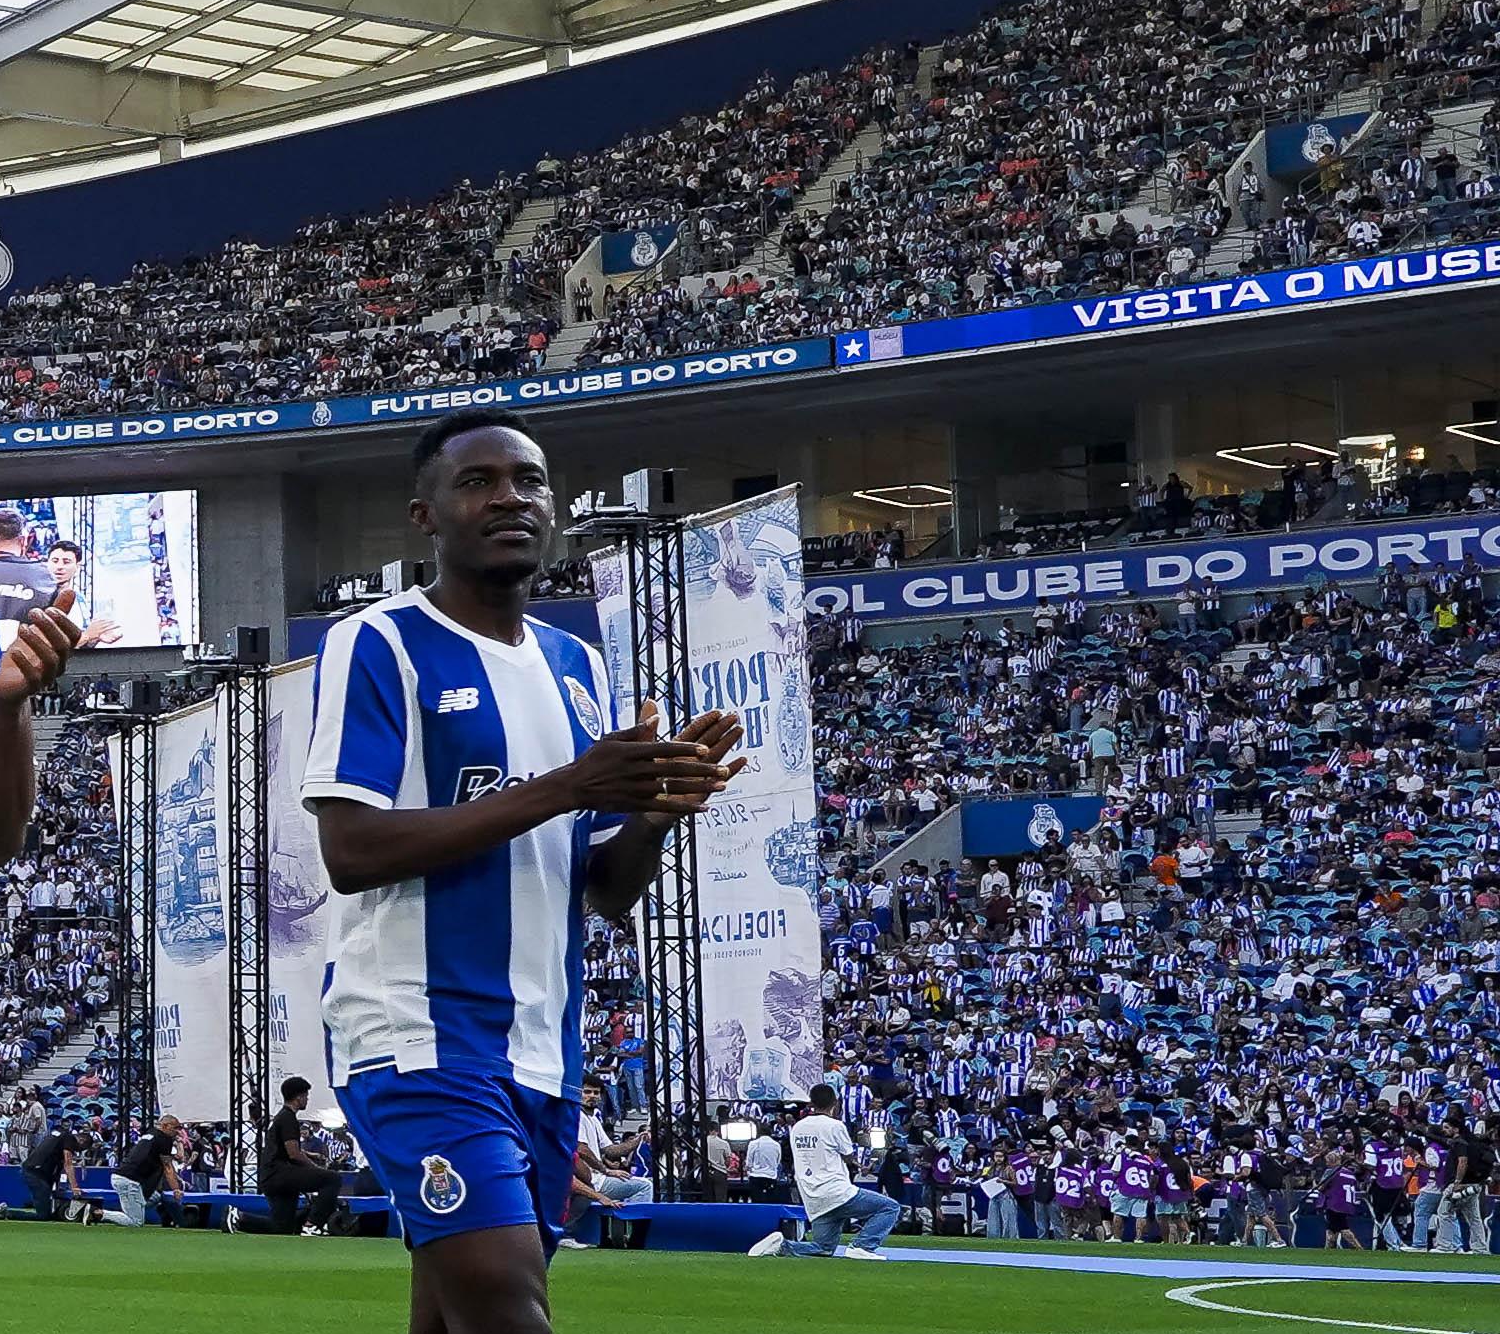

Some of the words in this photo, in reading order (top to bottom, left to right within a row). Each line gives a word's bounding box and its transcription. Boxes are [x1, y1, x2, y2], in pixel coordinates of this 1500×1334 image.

[1072, 284, 1272, 329] VISITA
[1285, 269, 1324, 300] O
[371, 384, 513, 416] FUTEBOL
[519, 370, 623, 399] CLUBE
[630, 364, 677, 384] DO
[684, 347, 799, 379] PORTO
[13, 422, 114, 443] CLUBE
[122, 417, 164, 436] DO
[173, 409, 279, 432] PORTO
[902, 561, 1125, 608] CLUBE
[1147, 551, 1249, 588] DO
[1055, 1178, 1081, 1198] 02
[1125, 1167, 1150, 1188] 63
